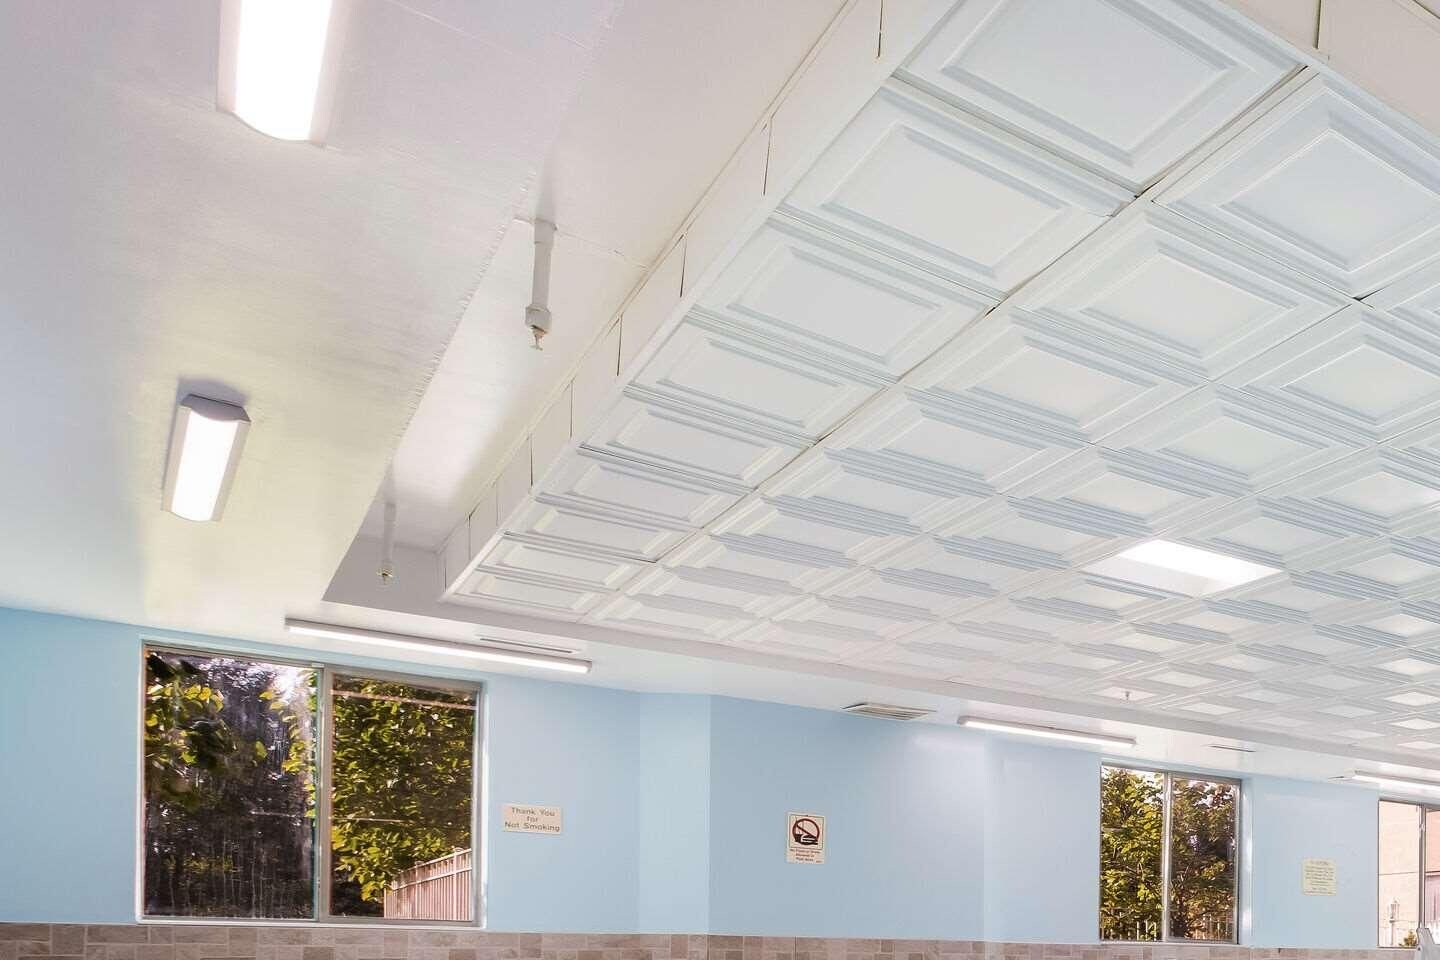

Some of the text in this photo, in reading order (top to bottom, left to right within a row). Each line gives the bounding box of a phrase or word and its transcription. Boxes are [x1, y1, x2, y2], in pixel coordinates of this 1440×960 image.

[511, 807, 556, 816] Thank You
[524, 822, 560, 832] Smoking
